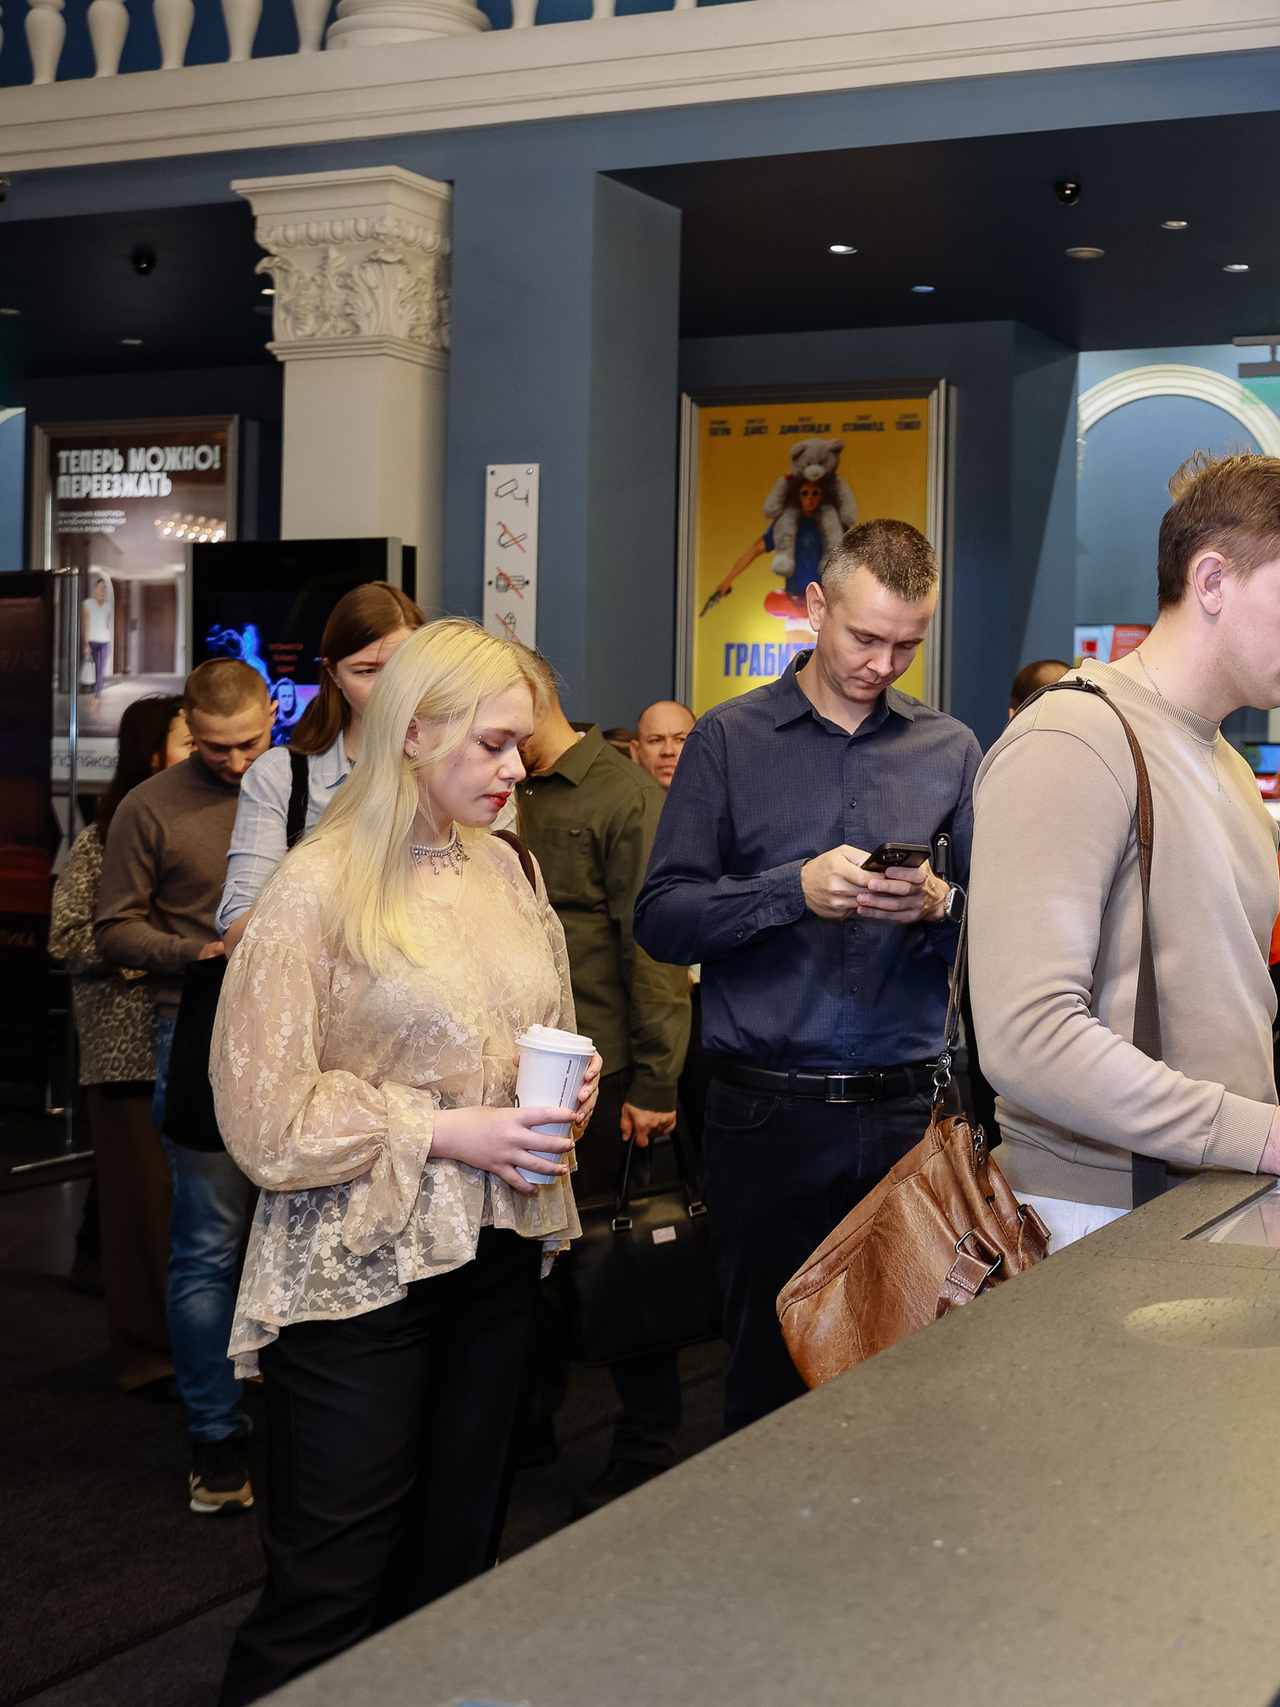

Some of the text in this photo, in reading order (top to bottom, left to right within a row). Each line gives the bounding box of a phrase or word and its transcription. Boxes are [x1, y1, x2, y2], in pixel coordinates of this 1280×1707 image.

[57, 444, 221, 474] ТЕПЕРЬ МОЖНО!
[57, 472, 172, 499] ПЕРЕЕЗЖАТЬ
[724, 642, 816, 677] ГРАБИ
